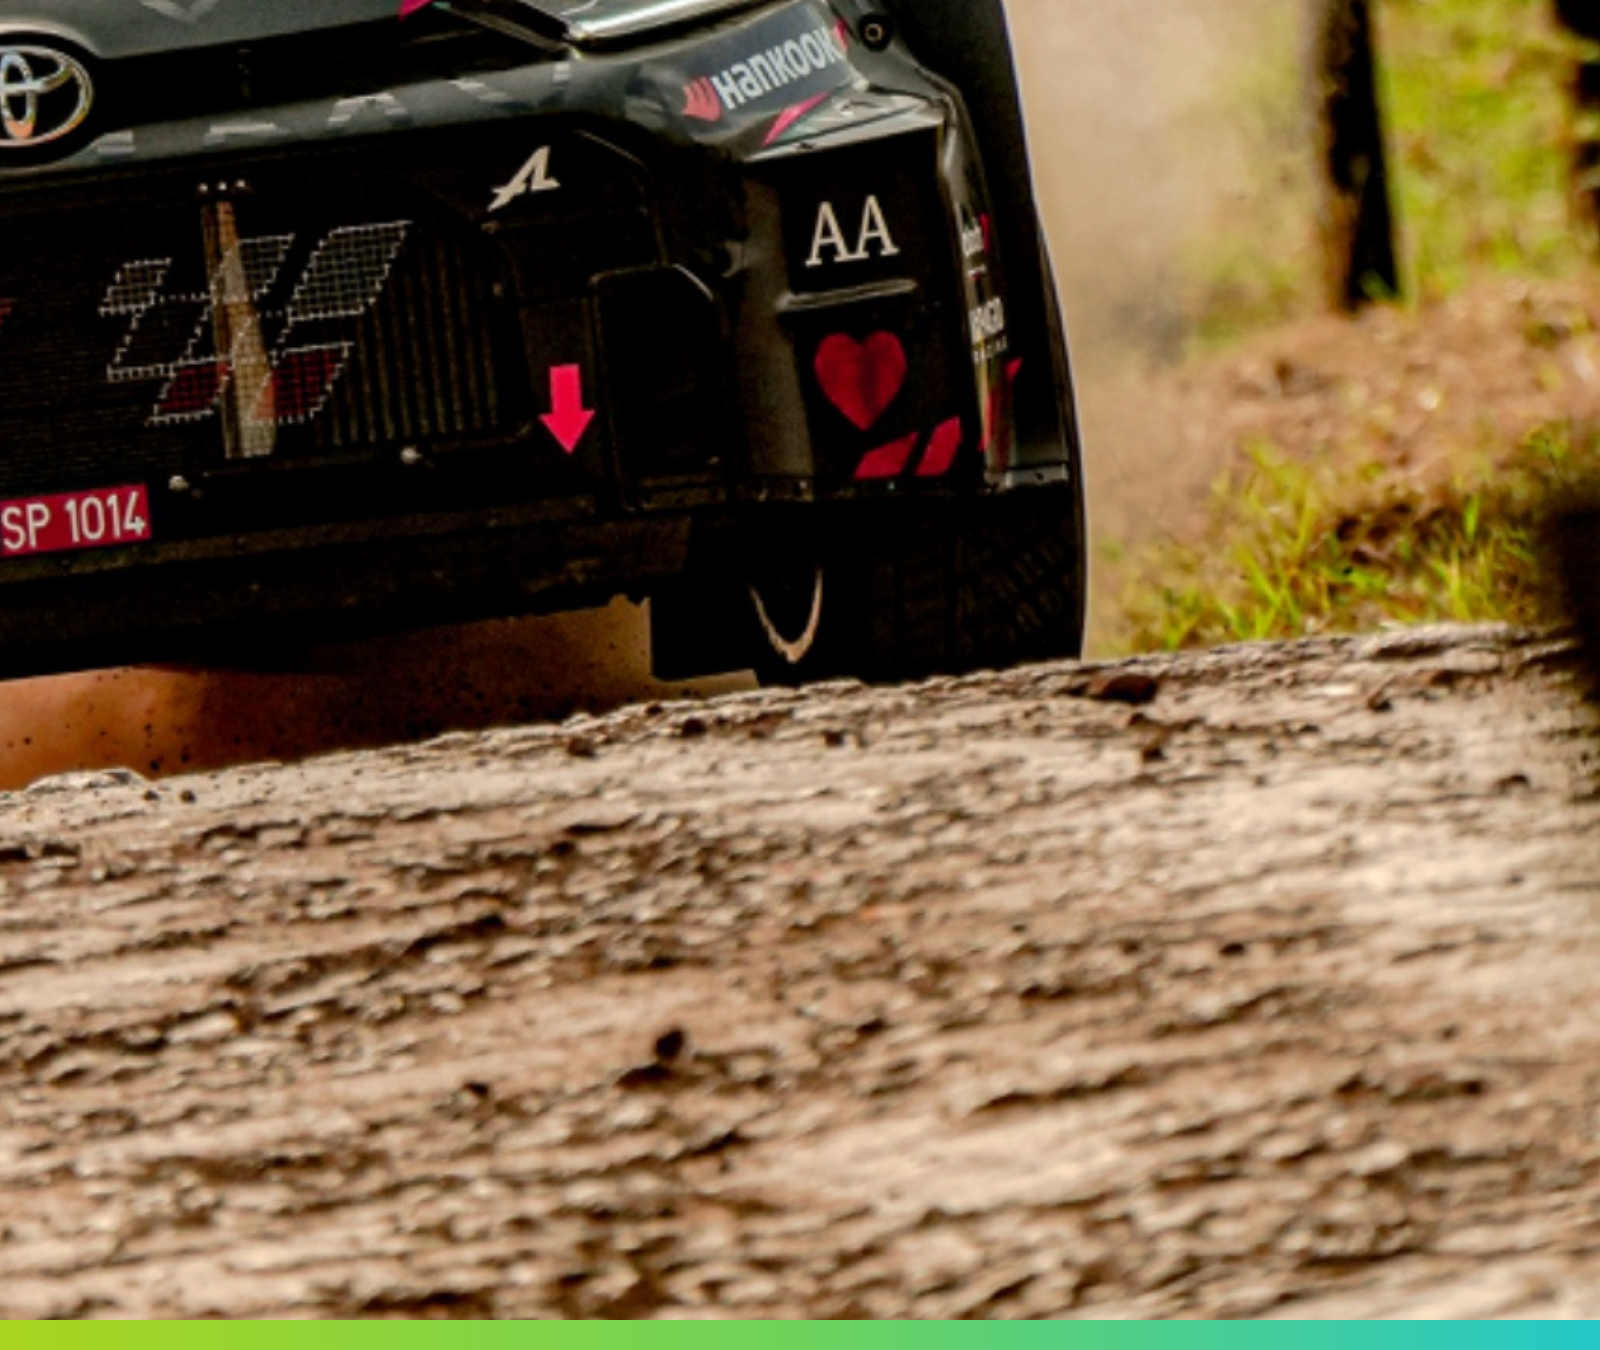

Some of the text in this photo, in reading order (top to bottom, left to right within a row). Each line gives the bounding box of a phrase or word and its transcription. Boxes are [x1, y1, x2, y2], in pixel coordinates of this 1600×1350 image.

[804, 195, 899, 267] AA
[1, 490, 147, 550] SP 1014
